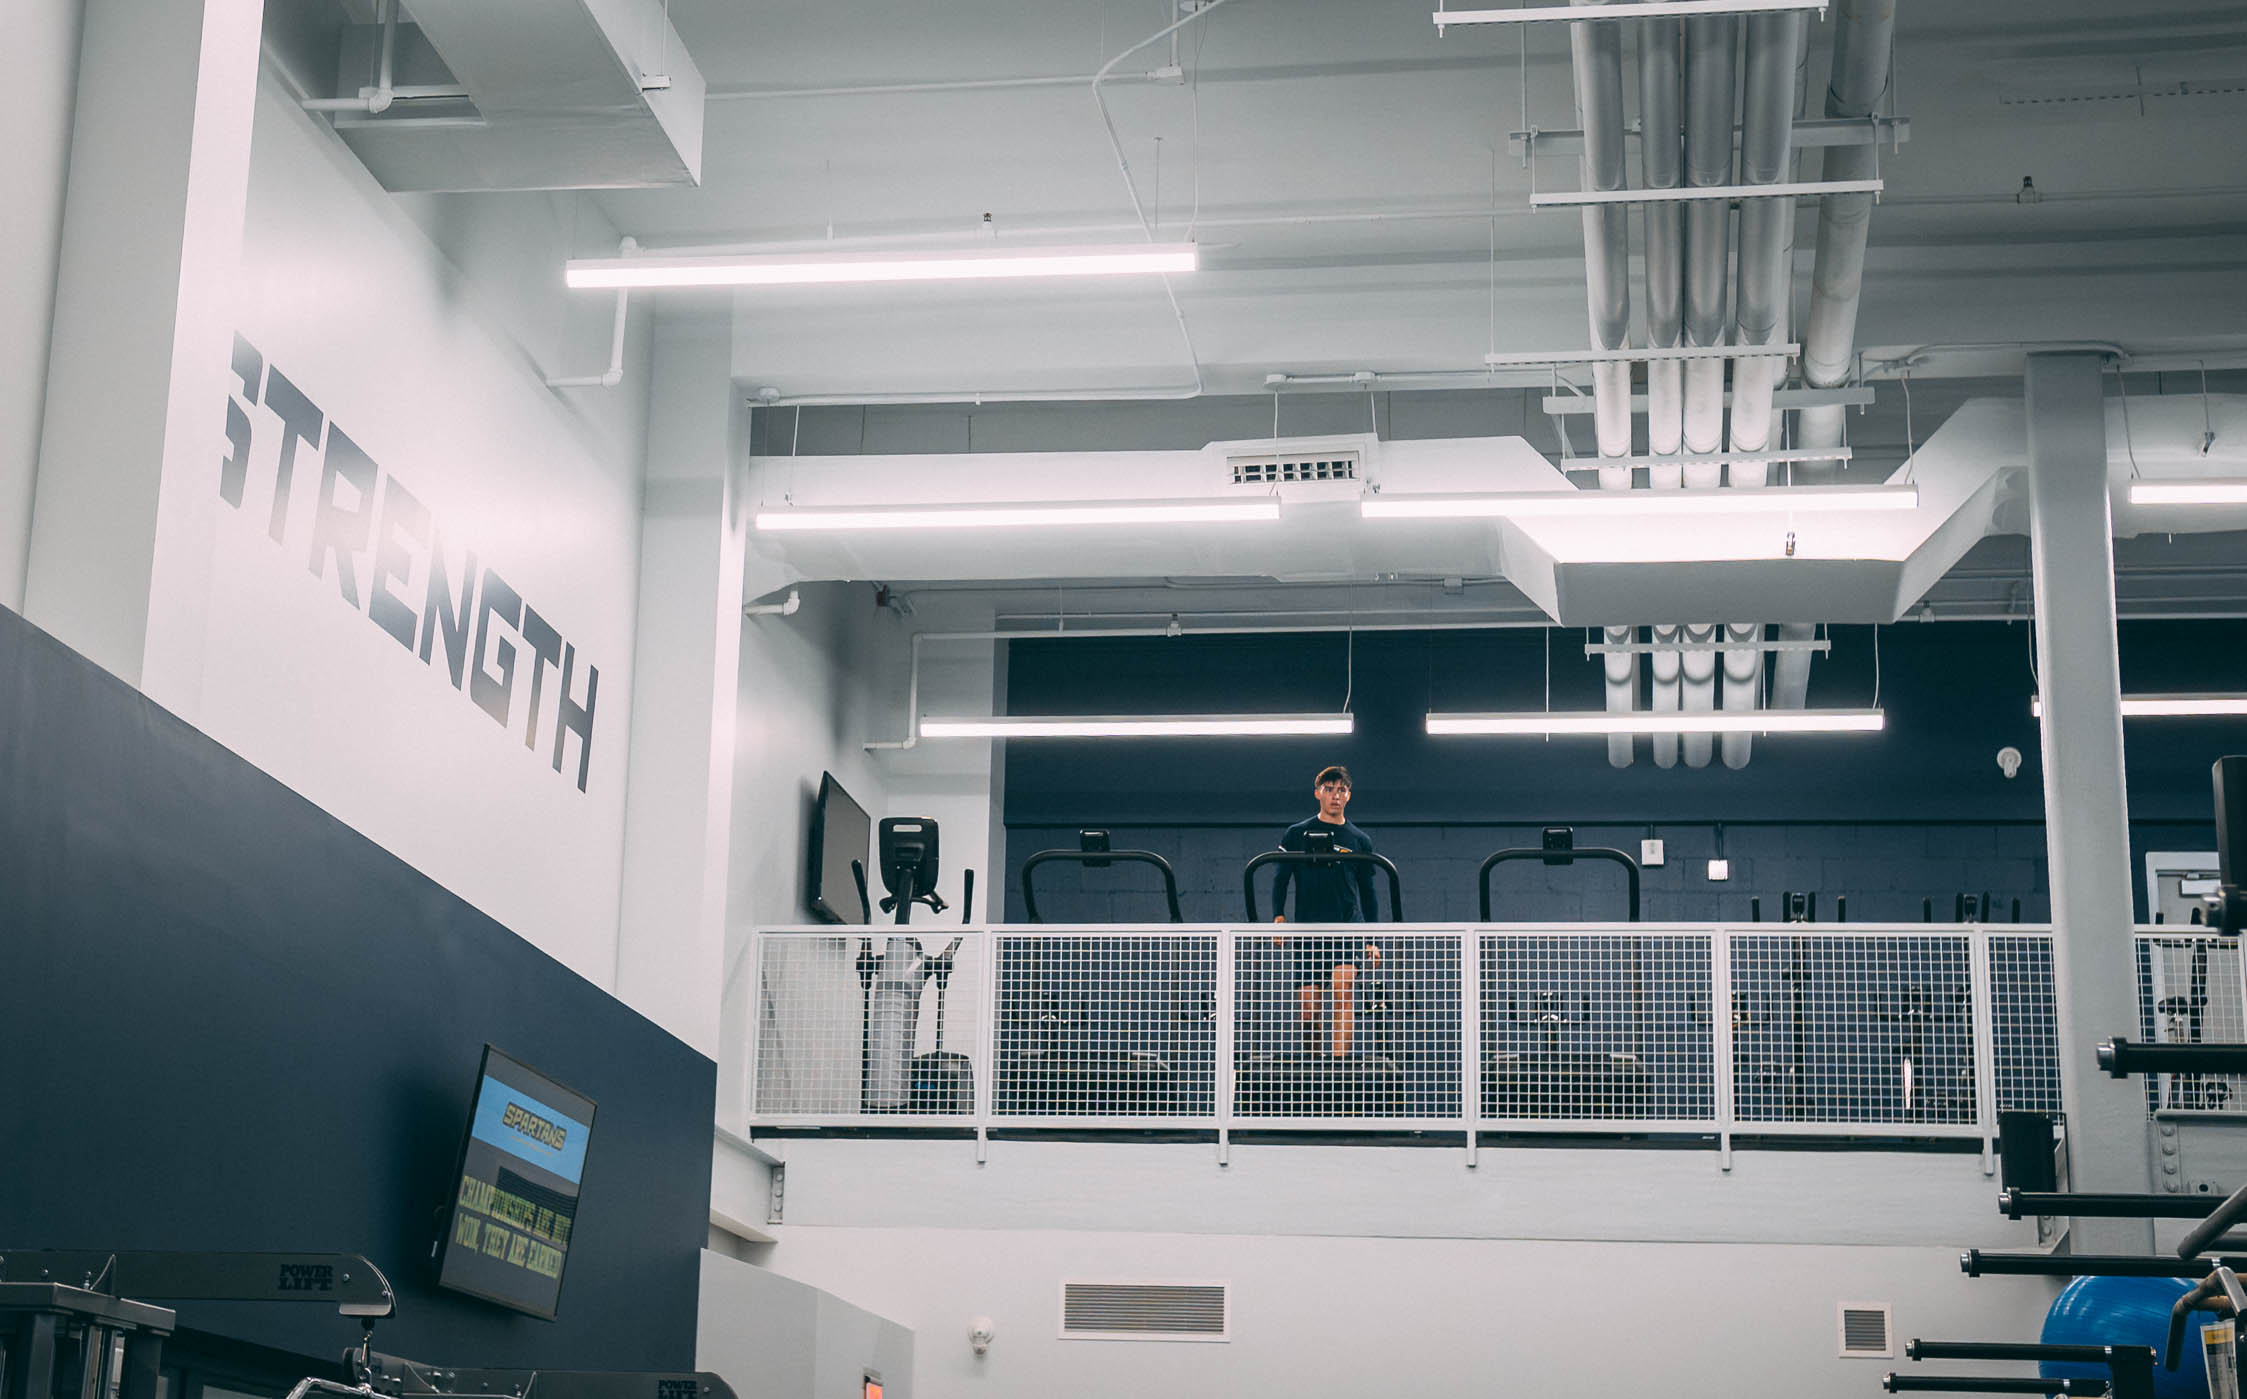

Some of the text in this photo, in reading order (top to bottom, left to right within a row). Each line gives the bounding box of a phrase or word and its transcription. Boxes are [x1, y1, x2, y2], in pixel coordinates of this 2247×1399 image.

[503, 1102, 567, 1151] SPARTANS
[482, 1222, 511, 1261] THEY
[506, 1232, 530, 1269] ARE
[279, 1263, 333, 1277] POWER
[278, 1277, 333, 1290] LIFT
[658, 1379, 697, 1390] POWER
